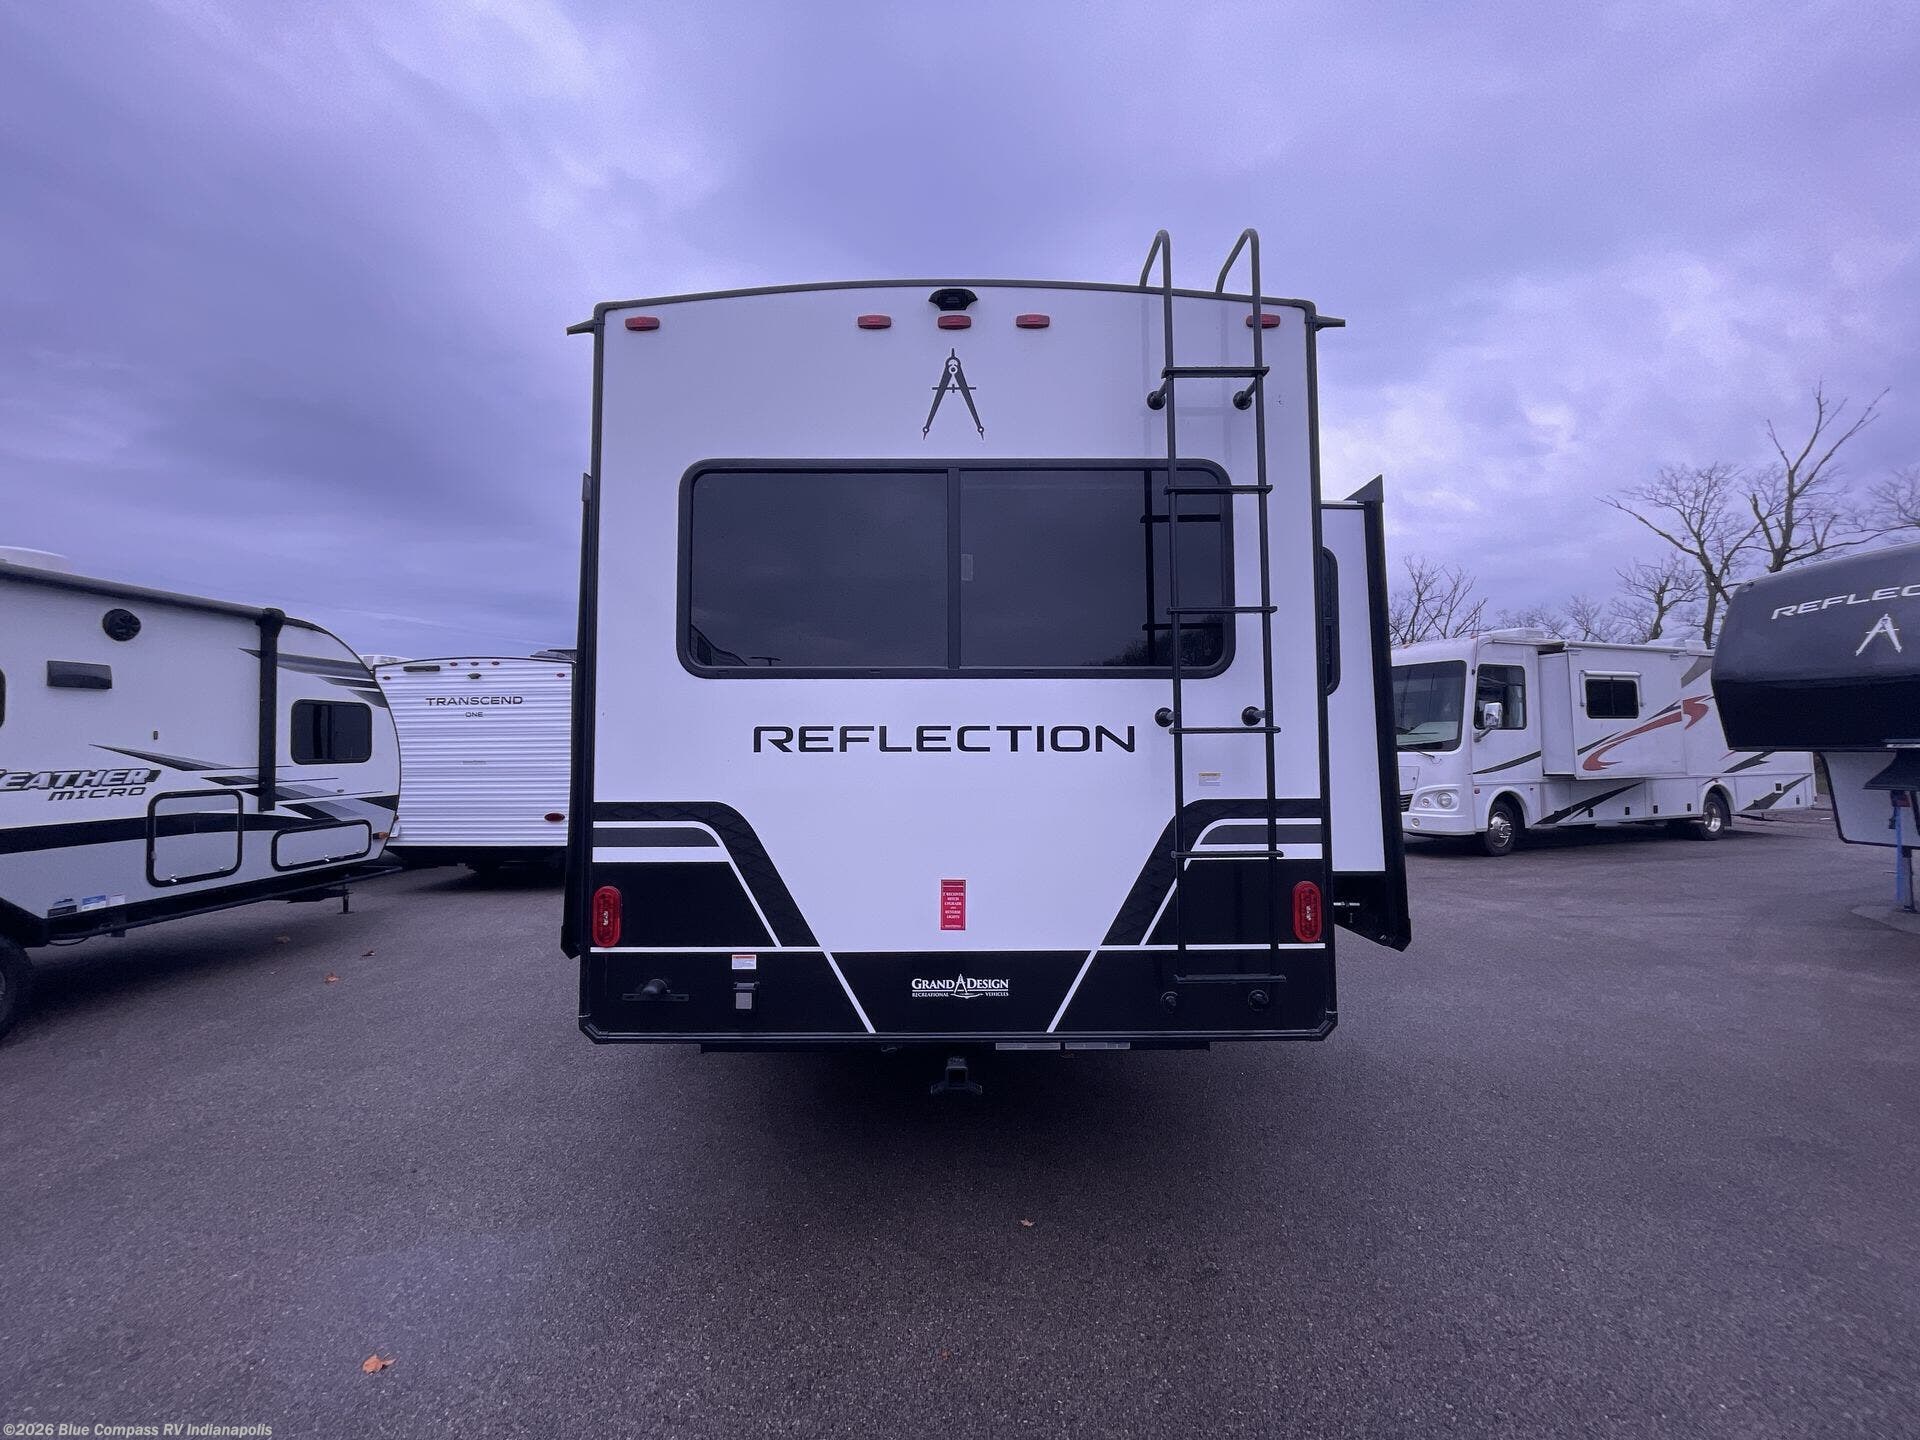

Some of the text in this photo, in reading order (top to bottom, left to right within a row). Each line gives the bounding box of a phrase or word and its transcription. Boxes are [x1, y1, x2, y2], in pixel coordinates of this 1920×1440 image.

[425, 696, 523, 706] TRANSCEND
[753, 725, 1136, 753] REFLECTION
[0, 768, 152, 792] EATHER
[48, 786, 146, 801] MICRO
[911, 978, 1009, 990] GRAND DESIGN
